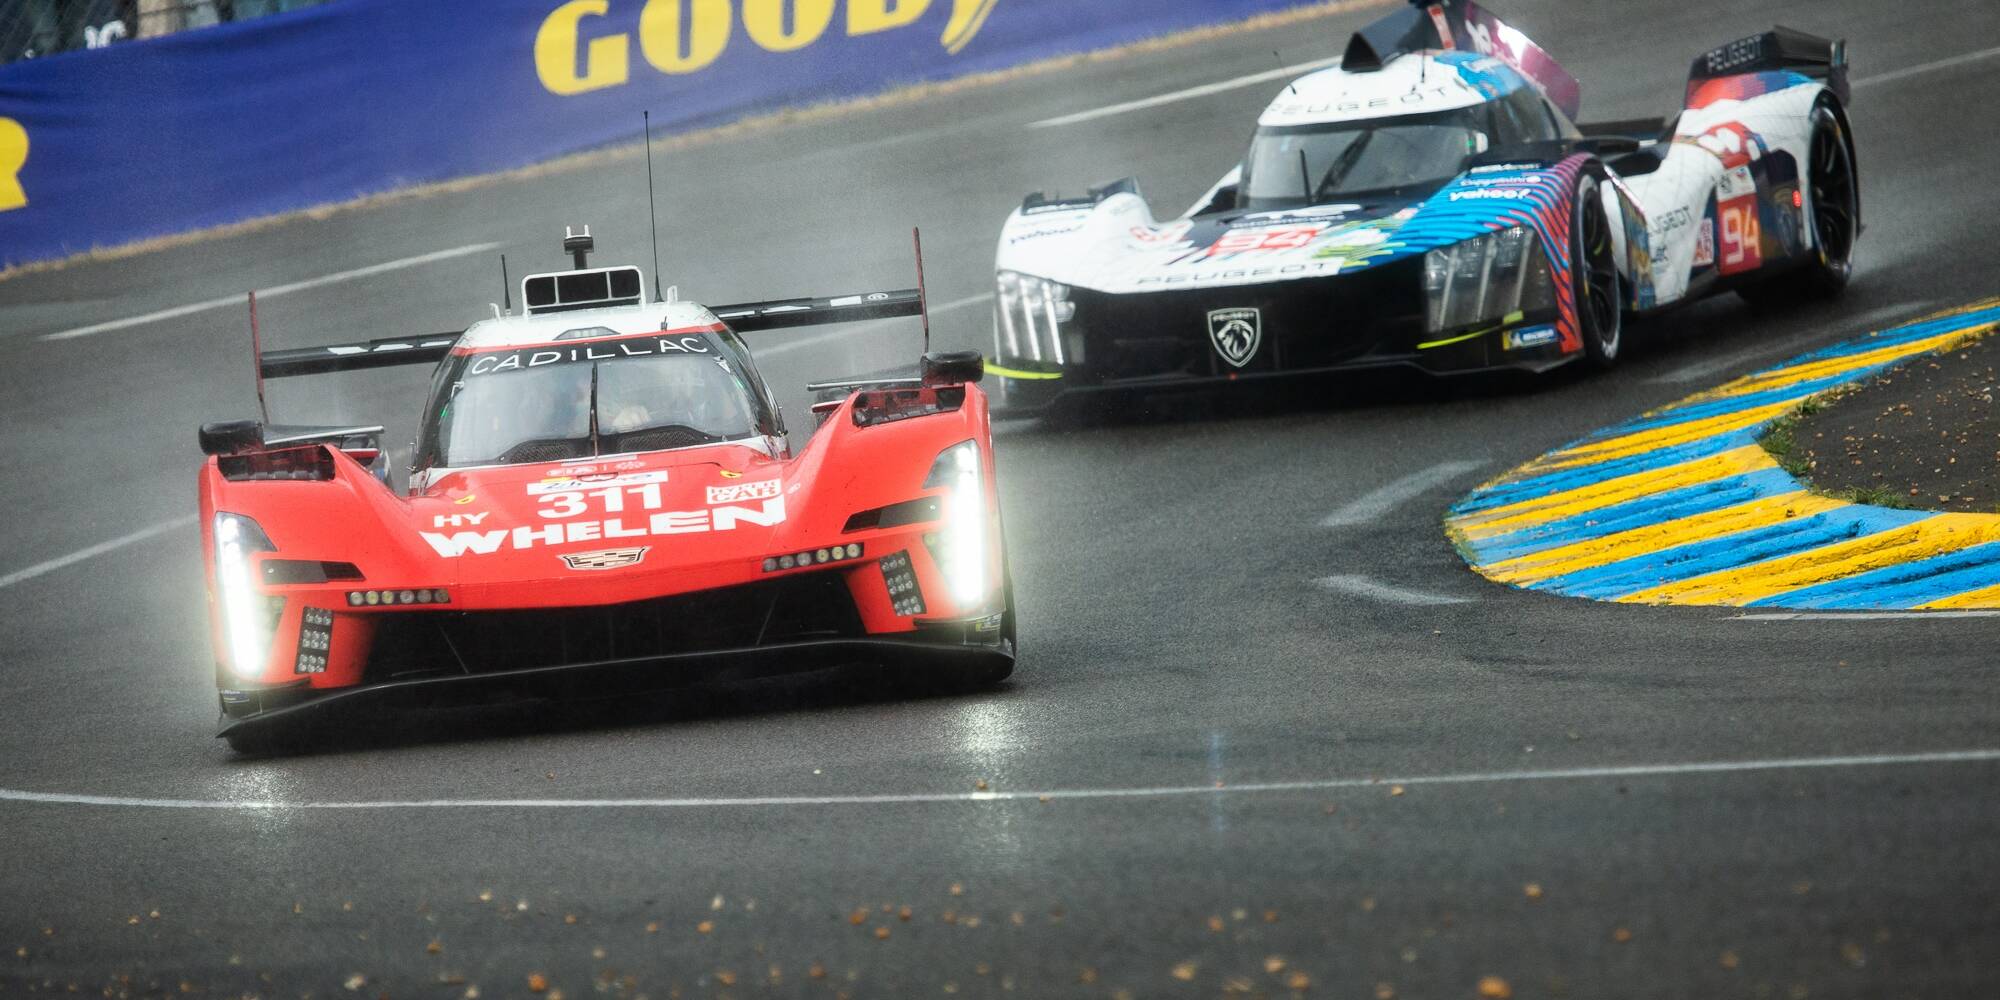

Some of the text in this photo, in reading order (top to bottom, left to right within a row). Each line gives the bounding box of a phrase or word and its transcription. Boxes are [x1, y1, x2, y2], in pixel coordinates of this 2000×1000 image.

[1706, 35, 1762, 73] PEUGEOT
[1450, 188, 1531, 202] yahoo!
[1649, 205, 1693, 237] UGEOT
[1723, 204, 1761, 265] 94
[1216, 228, 1316, 249] 94
[1137, 262, 1328, 285] PEUGEOT
[471, 336, 709, 375] CADILLAC
[537, 483, 662, 519] 311
[711, 486, 776, 502] CAR
[419, 494, 787, 558] WHELEN
[433, 511, 489, 528] HY
